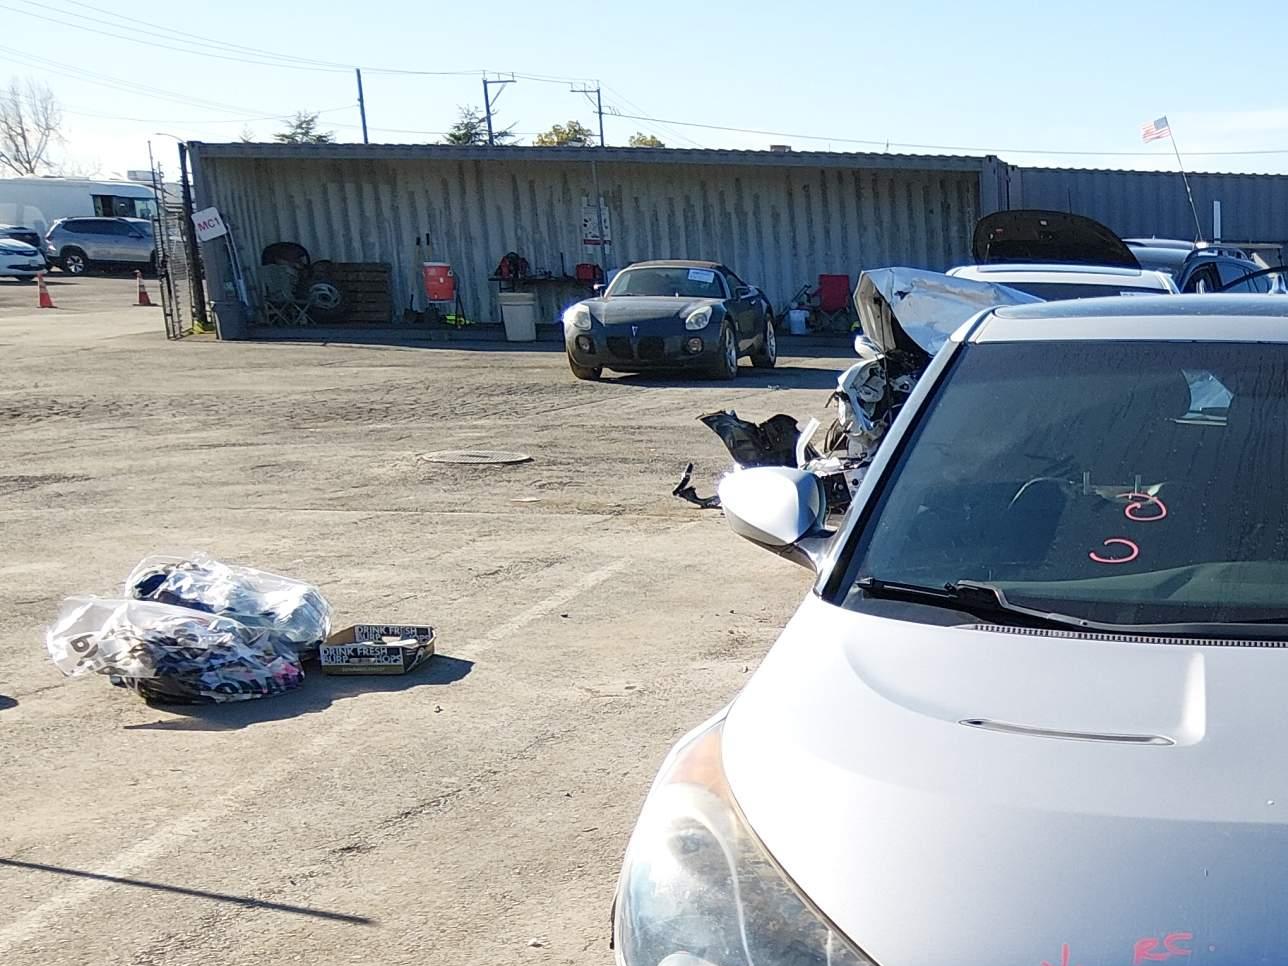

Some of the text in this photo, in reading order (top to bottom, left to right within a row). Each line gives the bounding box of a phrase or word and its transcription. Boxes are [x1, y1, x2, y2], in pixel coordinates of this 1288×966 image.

[197, 217, 220, 232] MC1
[357, 626, 386, 635] DRINK
[322, 647, 387, 656] DRINK FRESH
[322, 655, 401, 664] BURP HOPS
